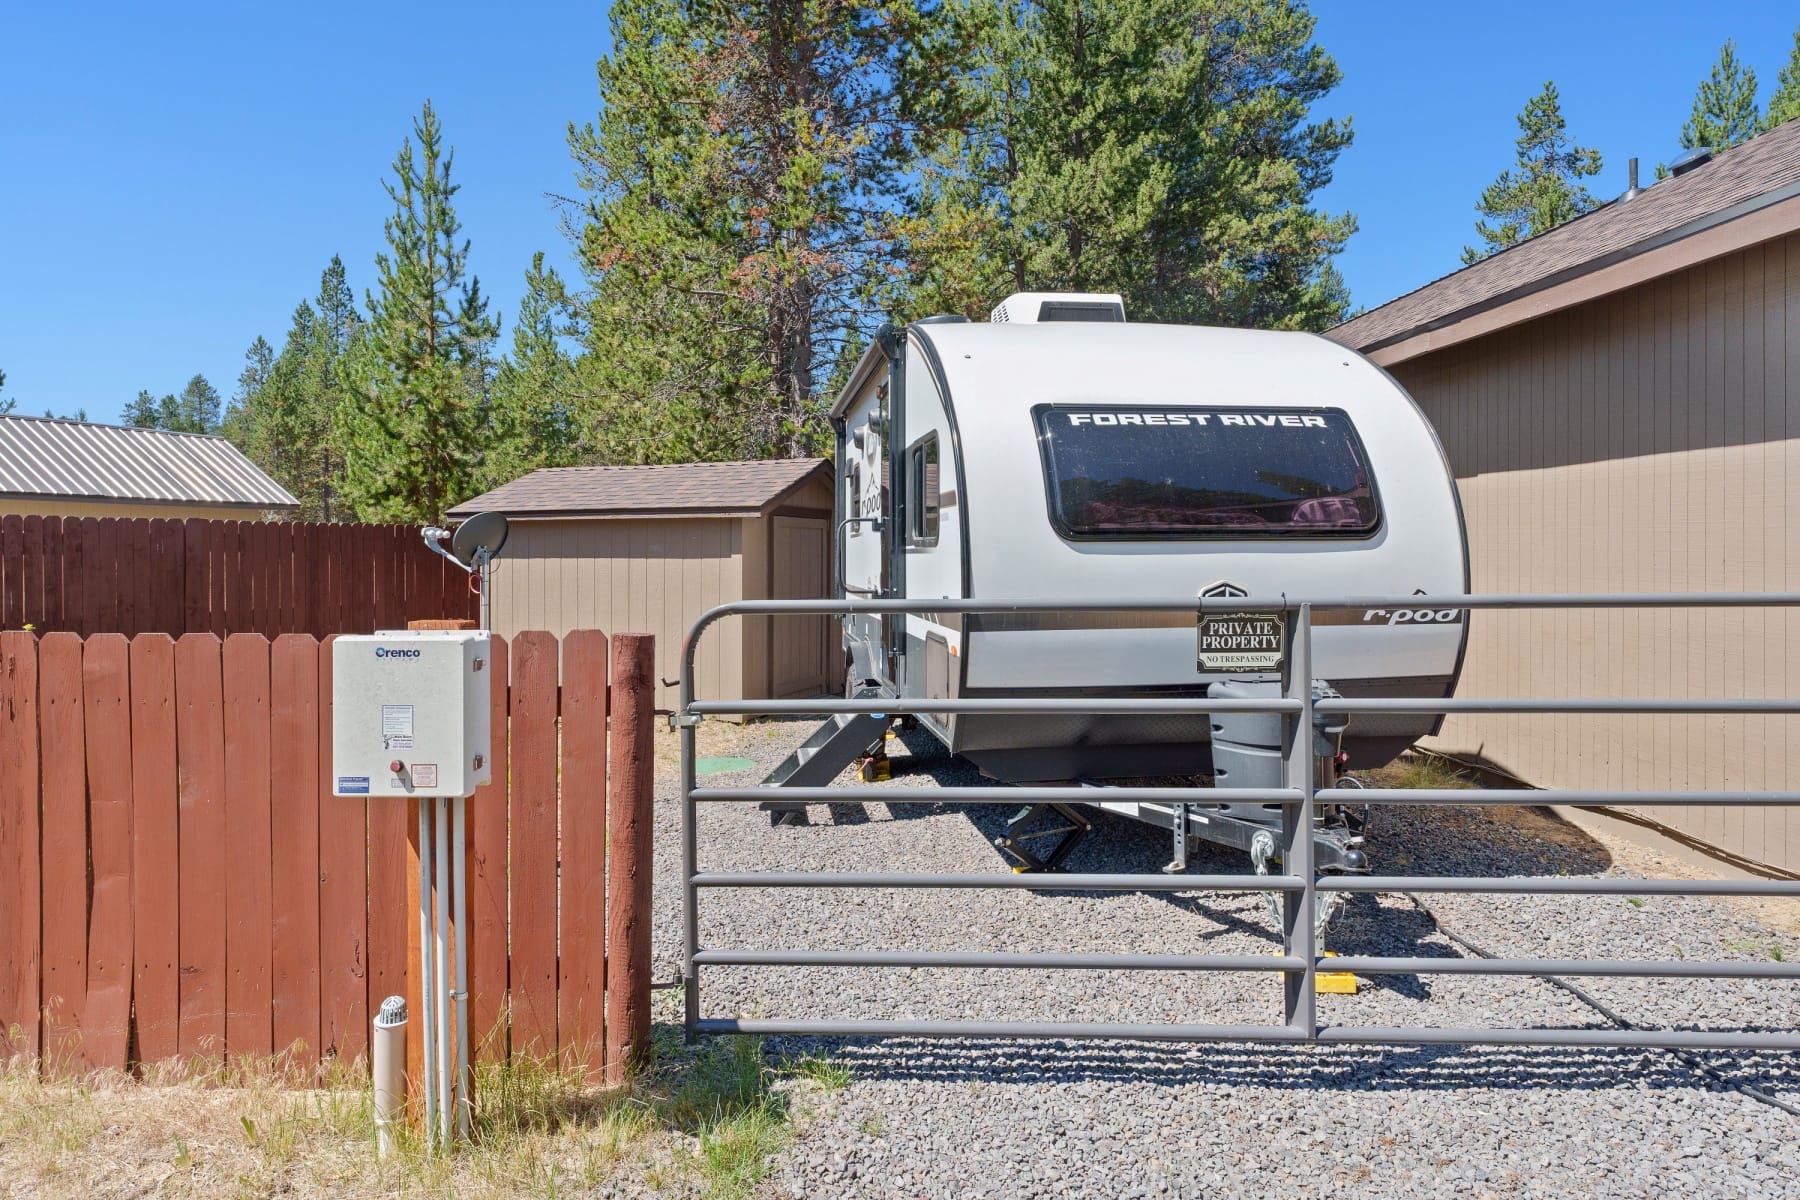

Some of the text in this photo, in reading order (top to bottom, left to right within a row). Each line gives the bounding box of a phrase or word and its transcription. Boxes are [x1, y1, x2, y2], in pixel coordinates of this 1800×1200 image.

[1068, 414, 1327, 427] FOREST RIVER
[1209, 622, 1272, 635] PRIVATE
[1202, 636, 1280, 648] PROPERTY
[376, 647, 420, 657] Orenco
[1206, 655, 1274, 663] NO TRESPASSING
